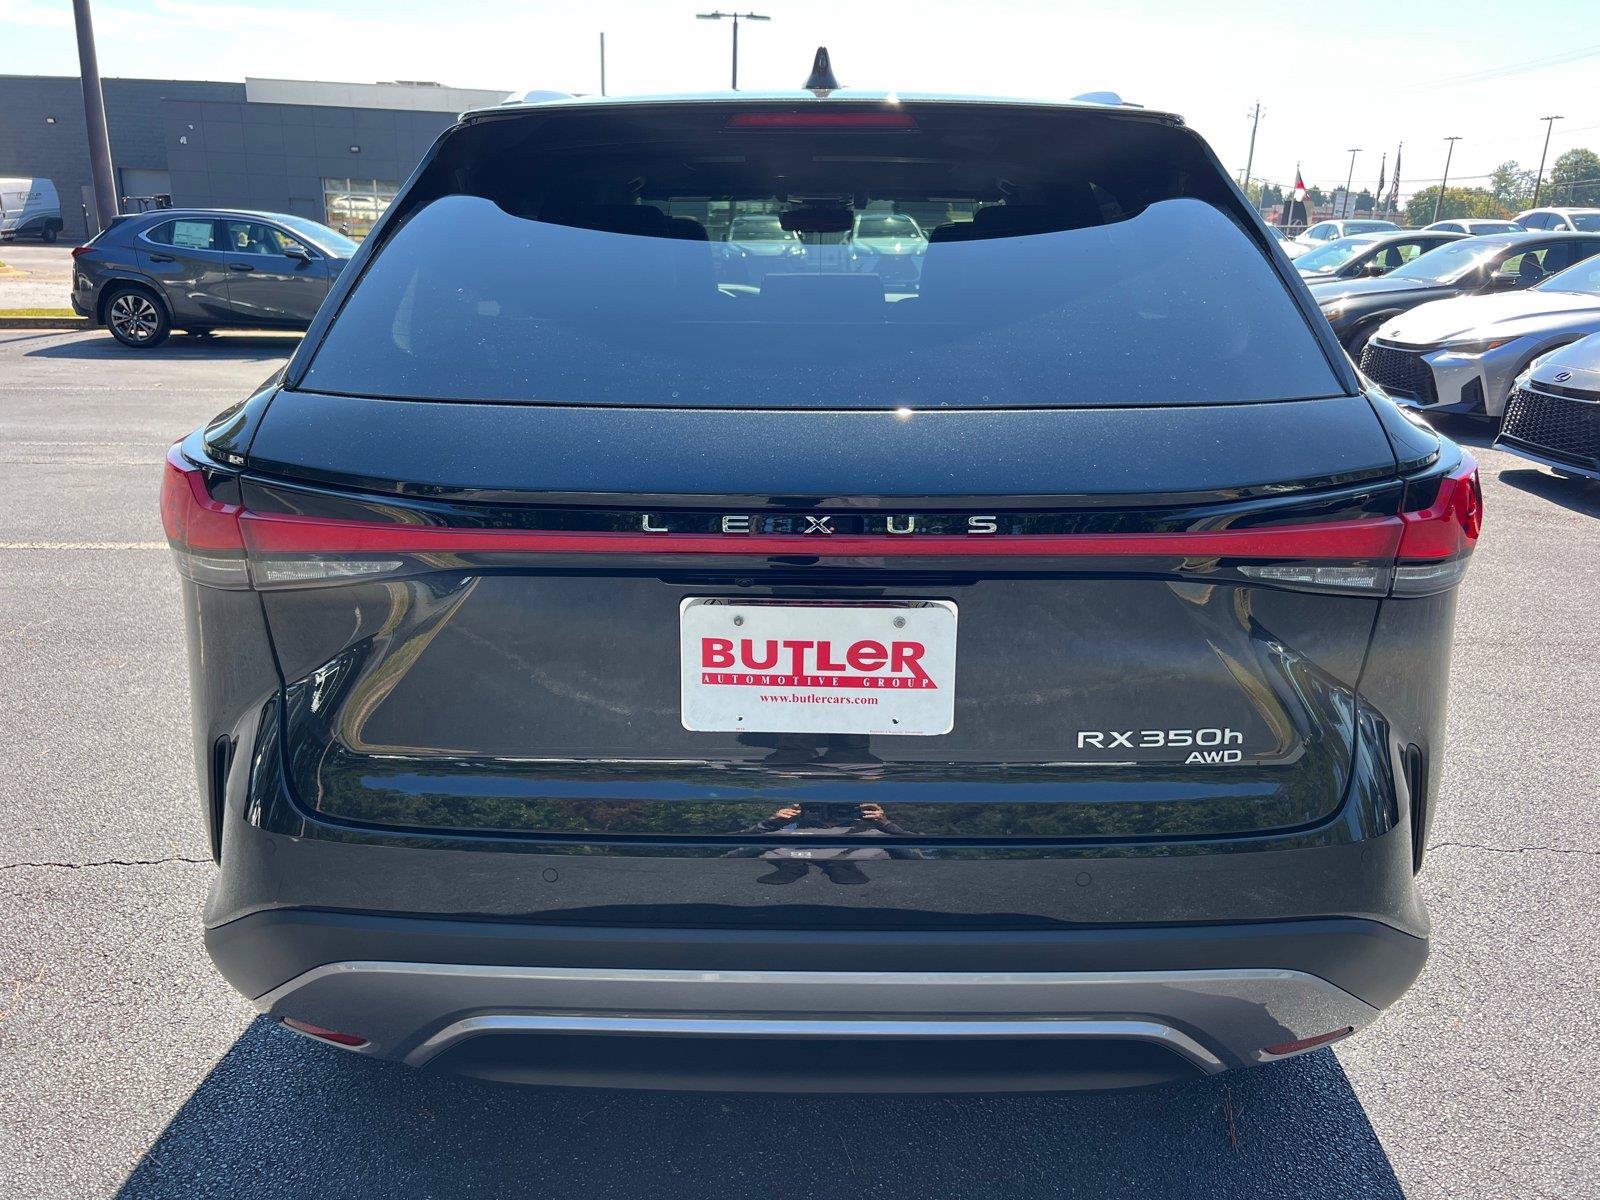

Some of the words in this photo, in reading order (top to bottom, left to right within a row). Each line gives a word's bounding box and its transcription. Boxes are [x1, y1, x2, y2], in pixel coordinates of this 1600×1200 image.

[642, 514, 997, 534] LEXUS
[702, 674, 838, 686] AUTOMOTIVE
[863, 677, 929, 688] GROUP
[760, 693, 879, 705] www.butlercars.com
[1185, 750, 1242, 764] AWD
